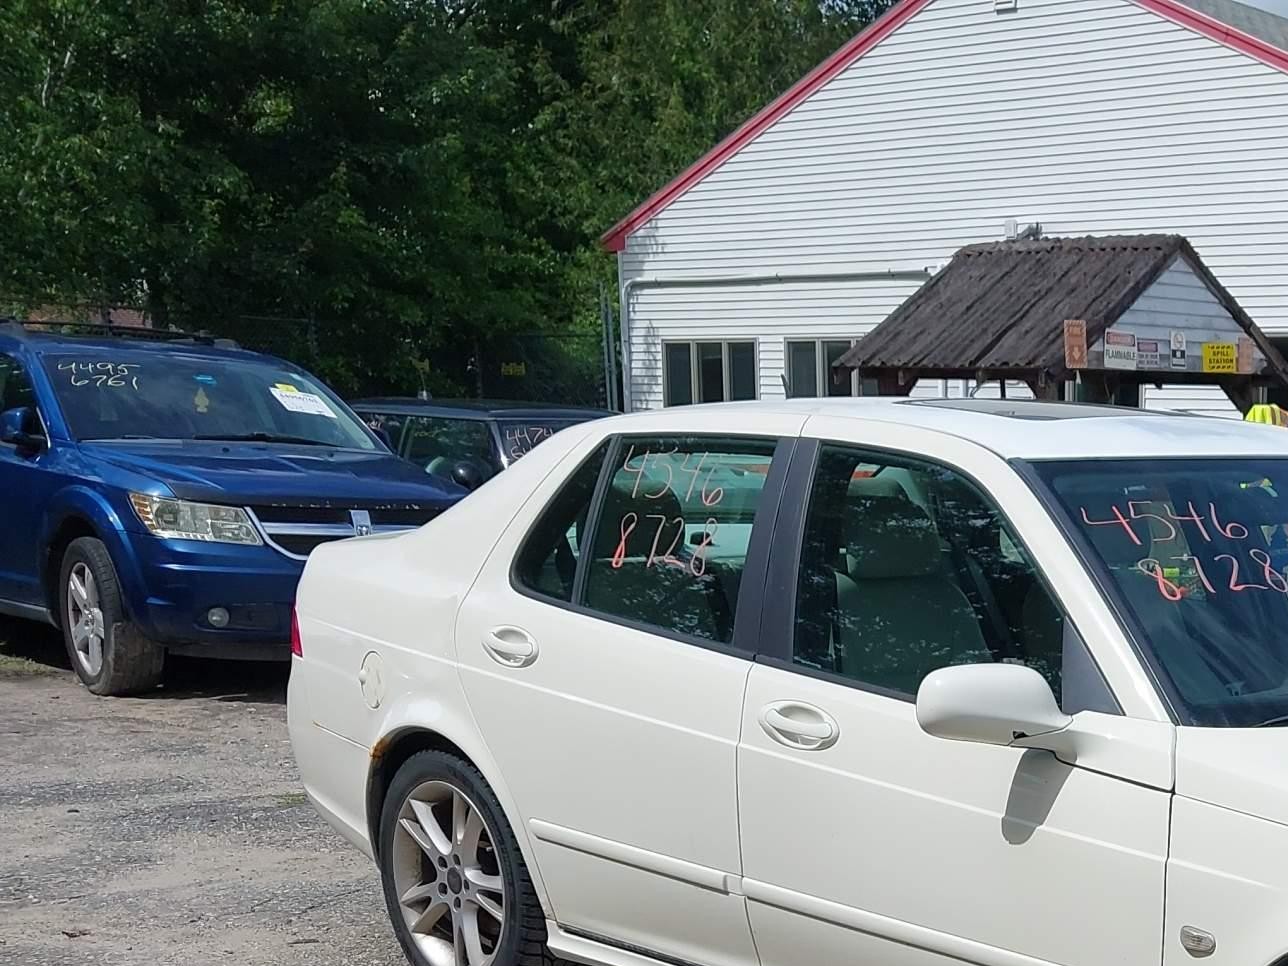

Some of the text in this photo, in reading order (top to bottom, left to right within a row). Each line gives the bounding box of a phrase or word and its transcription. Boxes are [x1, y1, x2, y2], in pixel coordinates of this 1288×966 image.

[58, 362, 141, 375] 4495
[71, 374, 138, 390] 6761
[623, 445, 723, 506] 4546
[612, 512, 718, 577] 8728
[1081, 501, 1248, 545] 4546
[1138, 549, 1288, 600] 8728
